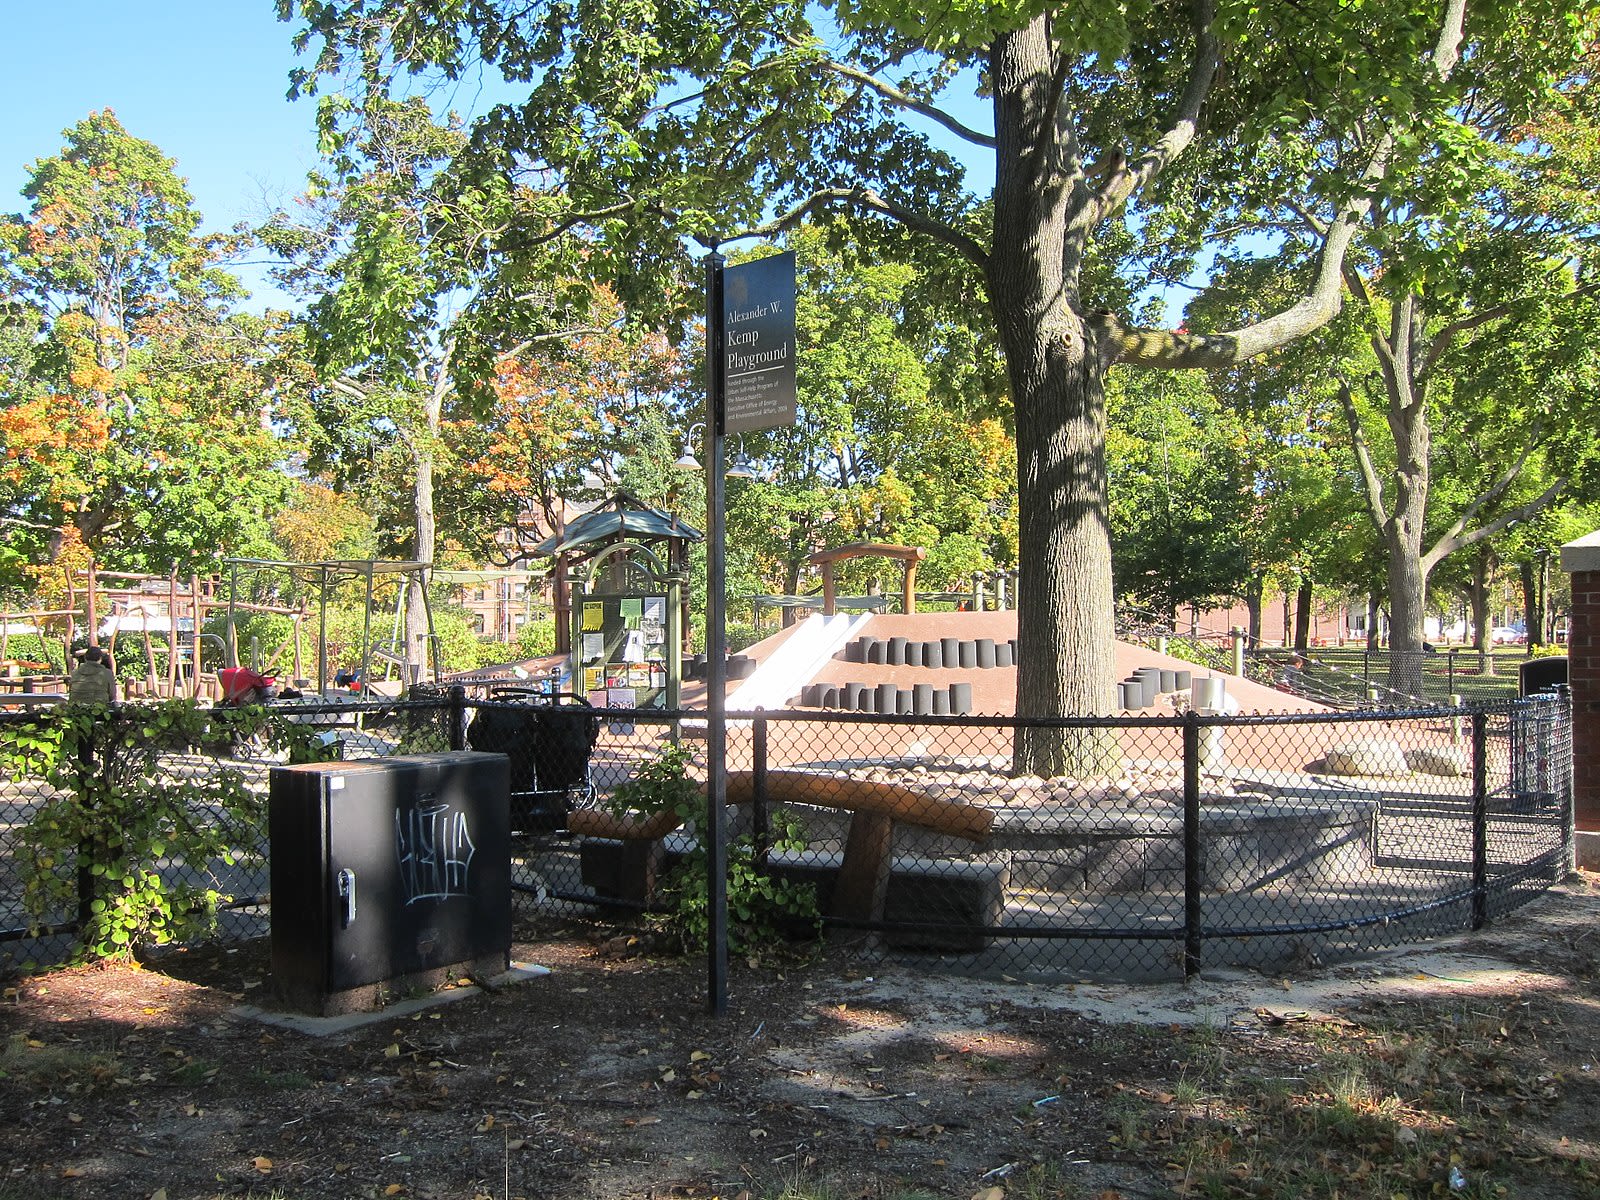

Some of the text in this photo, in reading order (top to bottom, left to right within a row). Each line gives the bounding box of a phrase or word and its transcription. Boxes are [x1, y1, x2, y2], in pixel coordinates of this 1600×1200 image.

[727, 300, 783, 324] Alexander W.
[727, 330, 759, 347] Kemp
[728, 341, 787, 371] Playground
